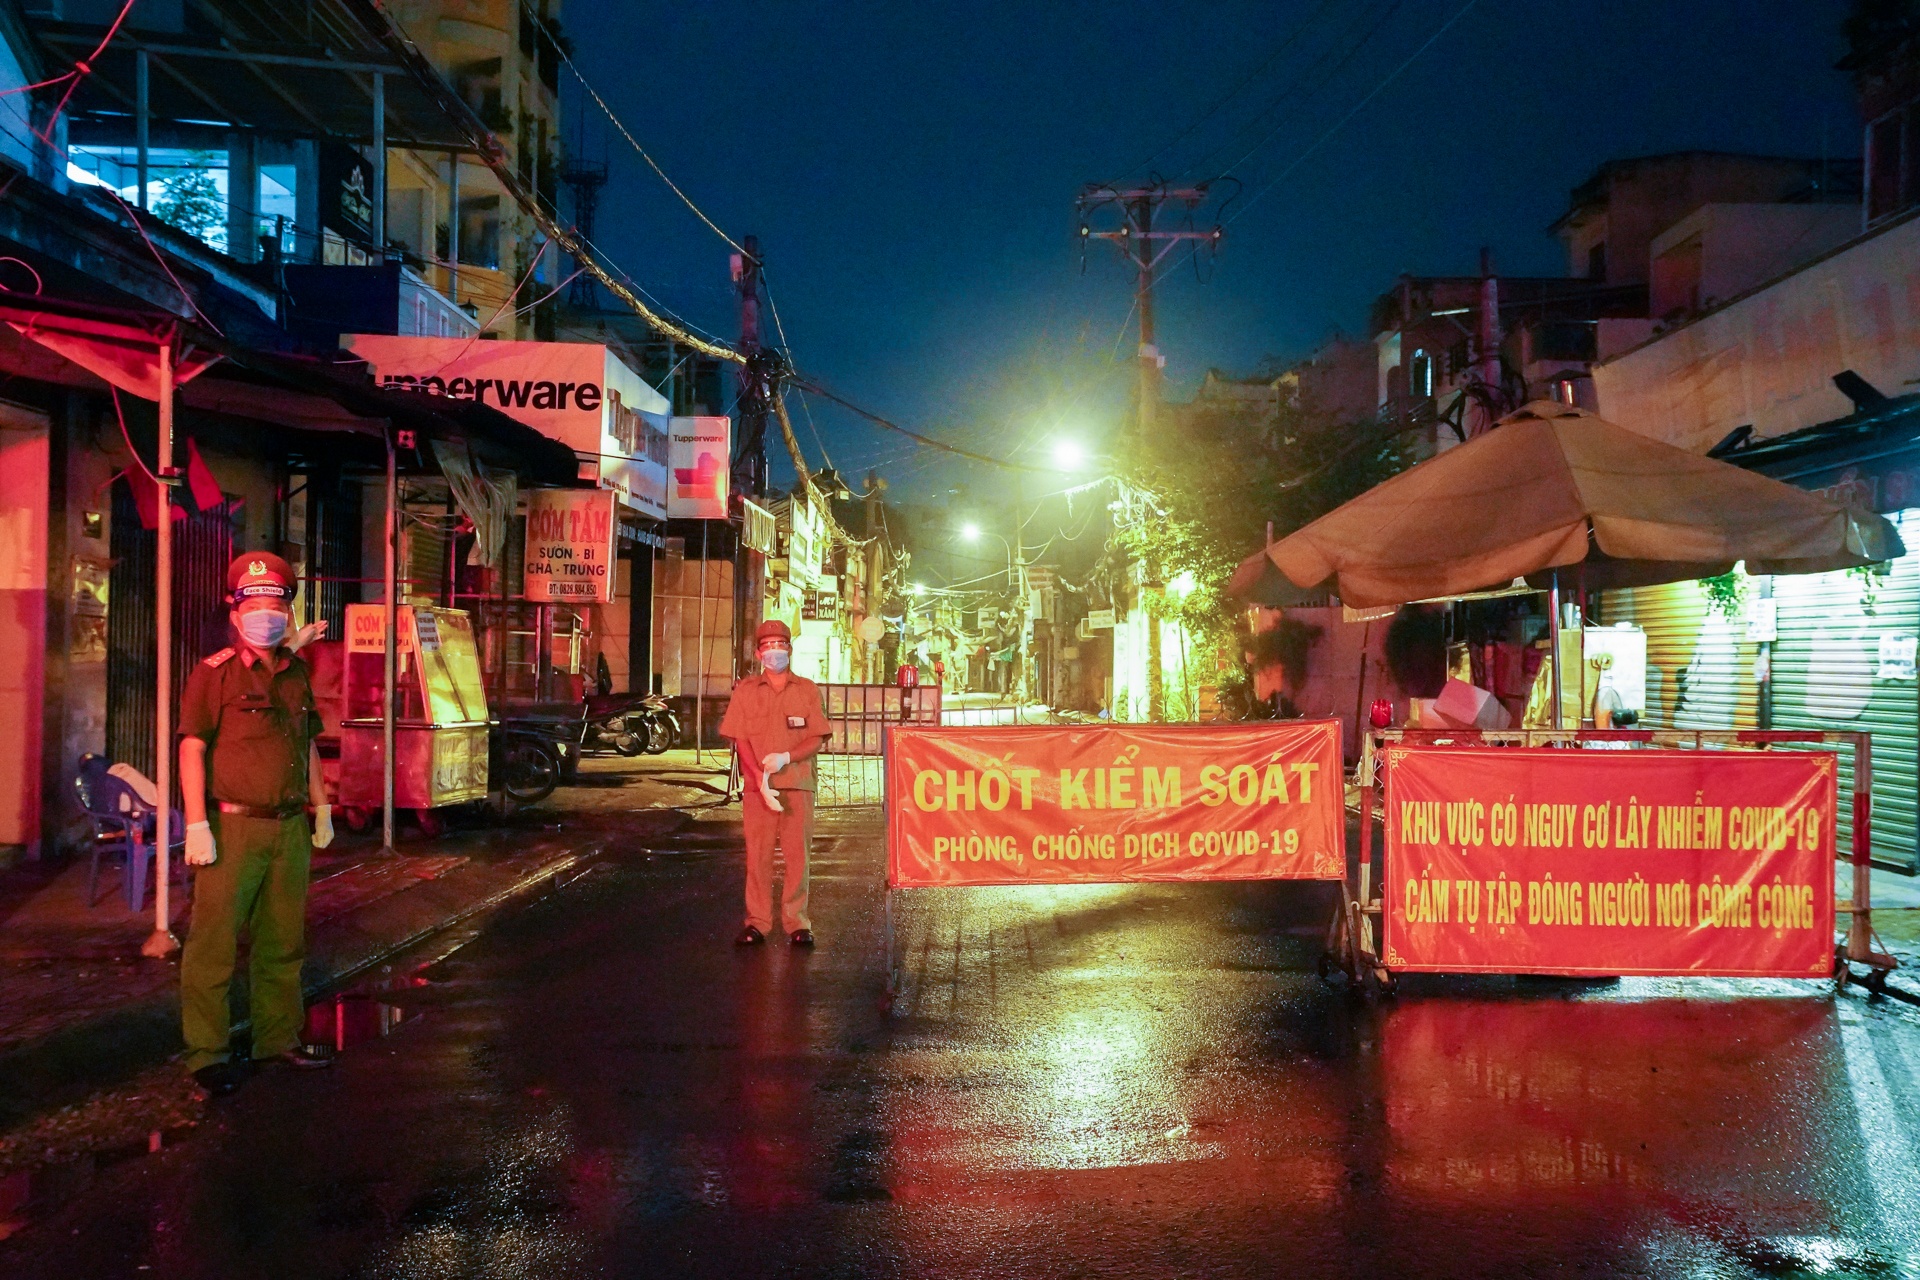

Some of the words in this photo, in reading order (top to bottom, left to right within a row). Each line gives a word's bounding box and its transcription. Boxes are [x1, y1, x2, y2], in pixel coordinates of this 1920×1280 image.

[673, 434, 724, 443] Tupperware
[528, 503, 565, 542] CƠM
[569, 495, 608, 544] TẤM
[539, 544, 573, 560] SƯỜN
[583, 545, 595, 560] BÌ
[562, 561, 605, 576] TRỨNG
[262, 587, 282, 595] Shield
[355, 612, 380, 633] CƠM
[913, 752, 1040, 812] CHỐT
[1061, 744, 1182, 810] KIỂM
[1199, 752, 1320, 807] SOÁT
[1401, 800, 1440, 846] KHU
[1445, 798, 1486, 856] VỰC
[1490, 794, 1517, 848] CÓ
[1523, 803, 1577, 848] NGUY
[1582, 800, 1611, 849] CƠ
[1615, 795, 1652, 849] LÂY
[1657, 790, 1722, 850] NHIỄM
[1729, 803, 1820, 852] COVID-19
[934, 830, 1024, 866] PHÒNG,
[1032, 825, 1116, 862] CHỐNG
[1124, 832, 1180, 865] DỊCH
[1189, 829, 1299, 858] COVID-19
[1405, 864, 1449, 924] CẤM
[1456, 880, 1480, 934] TỤ
[1486, 871, 1522, 935] TẬP
[1528, 872, 1582, 927] ĐÔNG
[1588, 872, 1650, 927] NGƯỜI
[1656, 882, 1691, 928] NƠI
[1698, 875, 1752, 929] CÔNG
[1758, 875, 1814, 938] CỘNG
